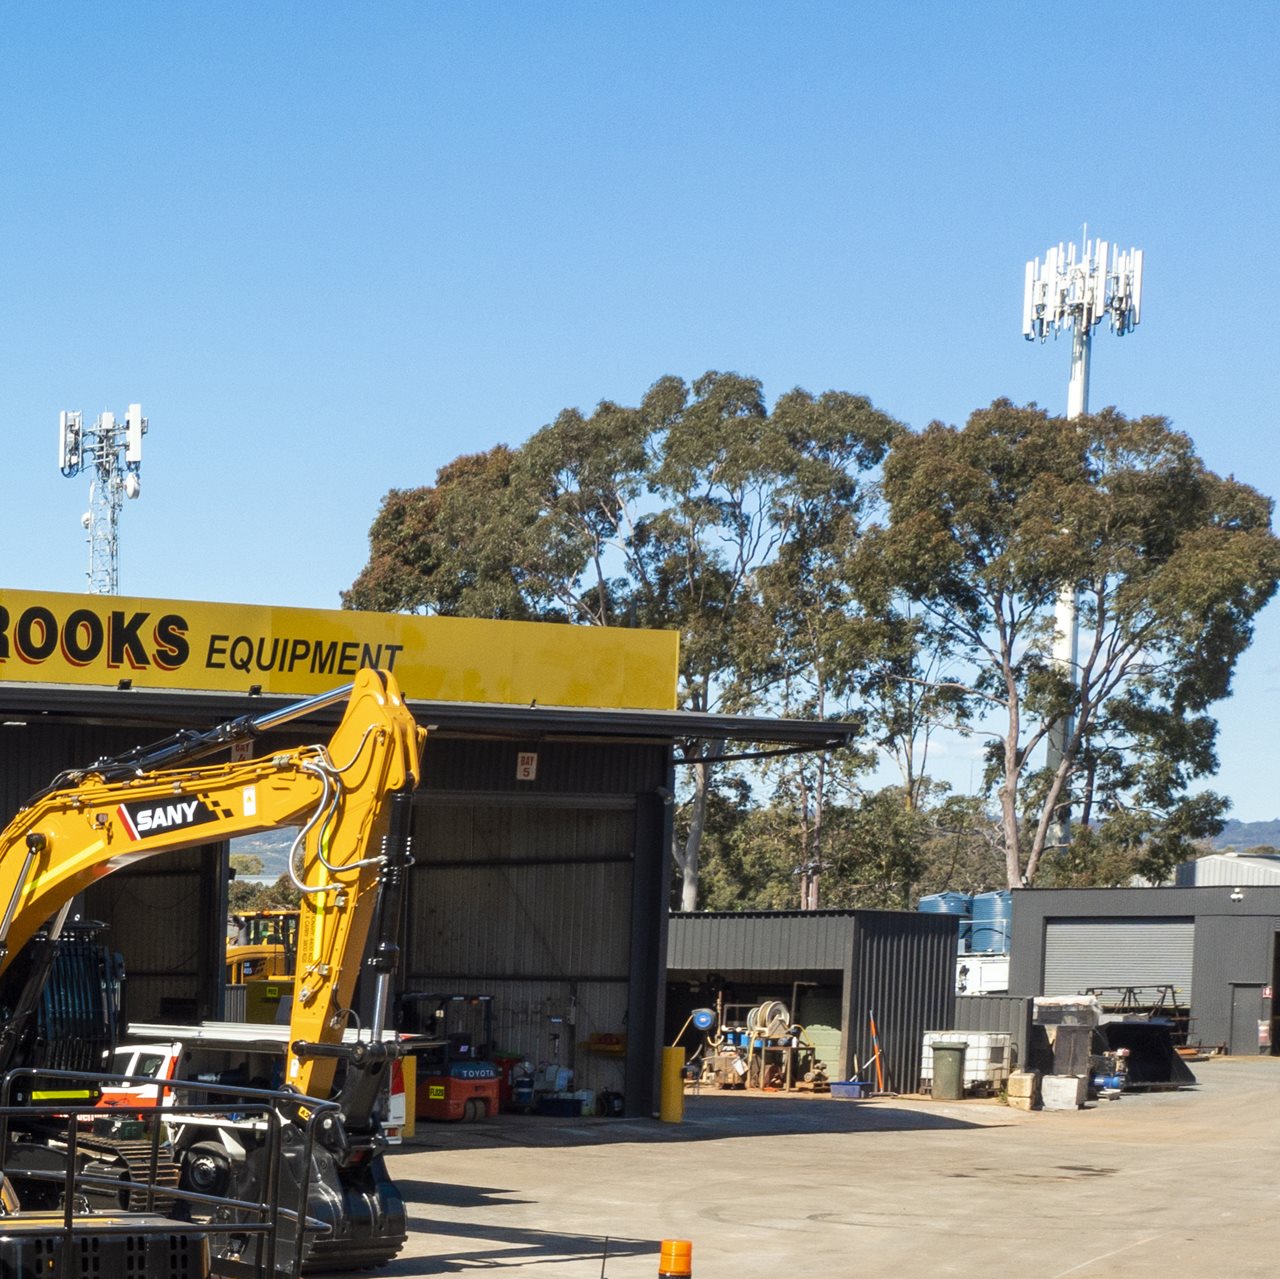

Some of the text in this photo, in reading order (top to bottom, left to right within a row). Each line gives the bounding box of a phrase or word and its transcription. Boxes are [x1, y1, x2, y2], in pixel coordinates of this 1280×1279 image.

[205, 634, 404, 676] EQUIPMENT
[136, 800, 198, 831] SANY
[462, 1069, 495, 1077] TOYOTA
